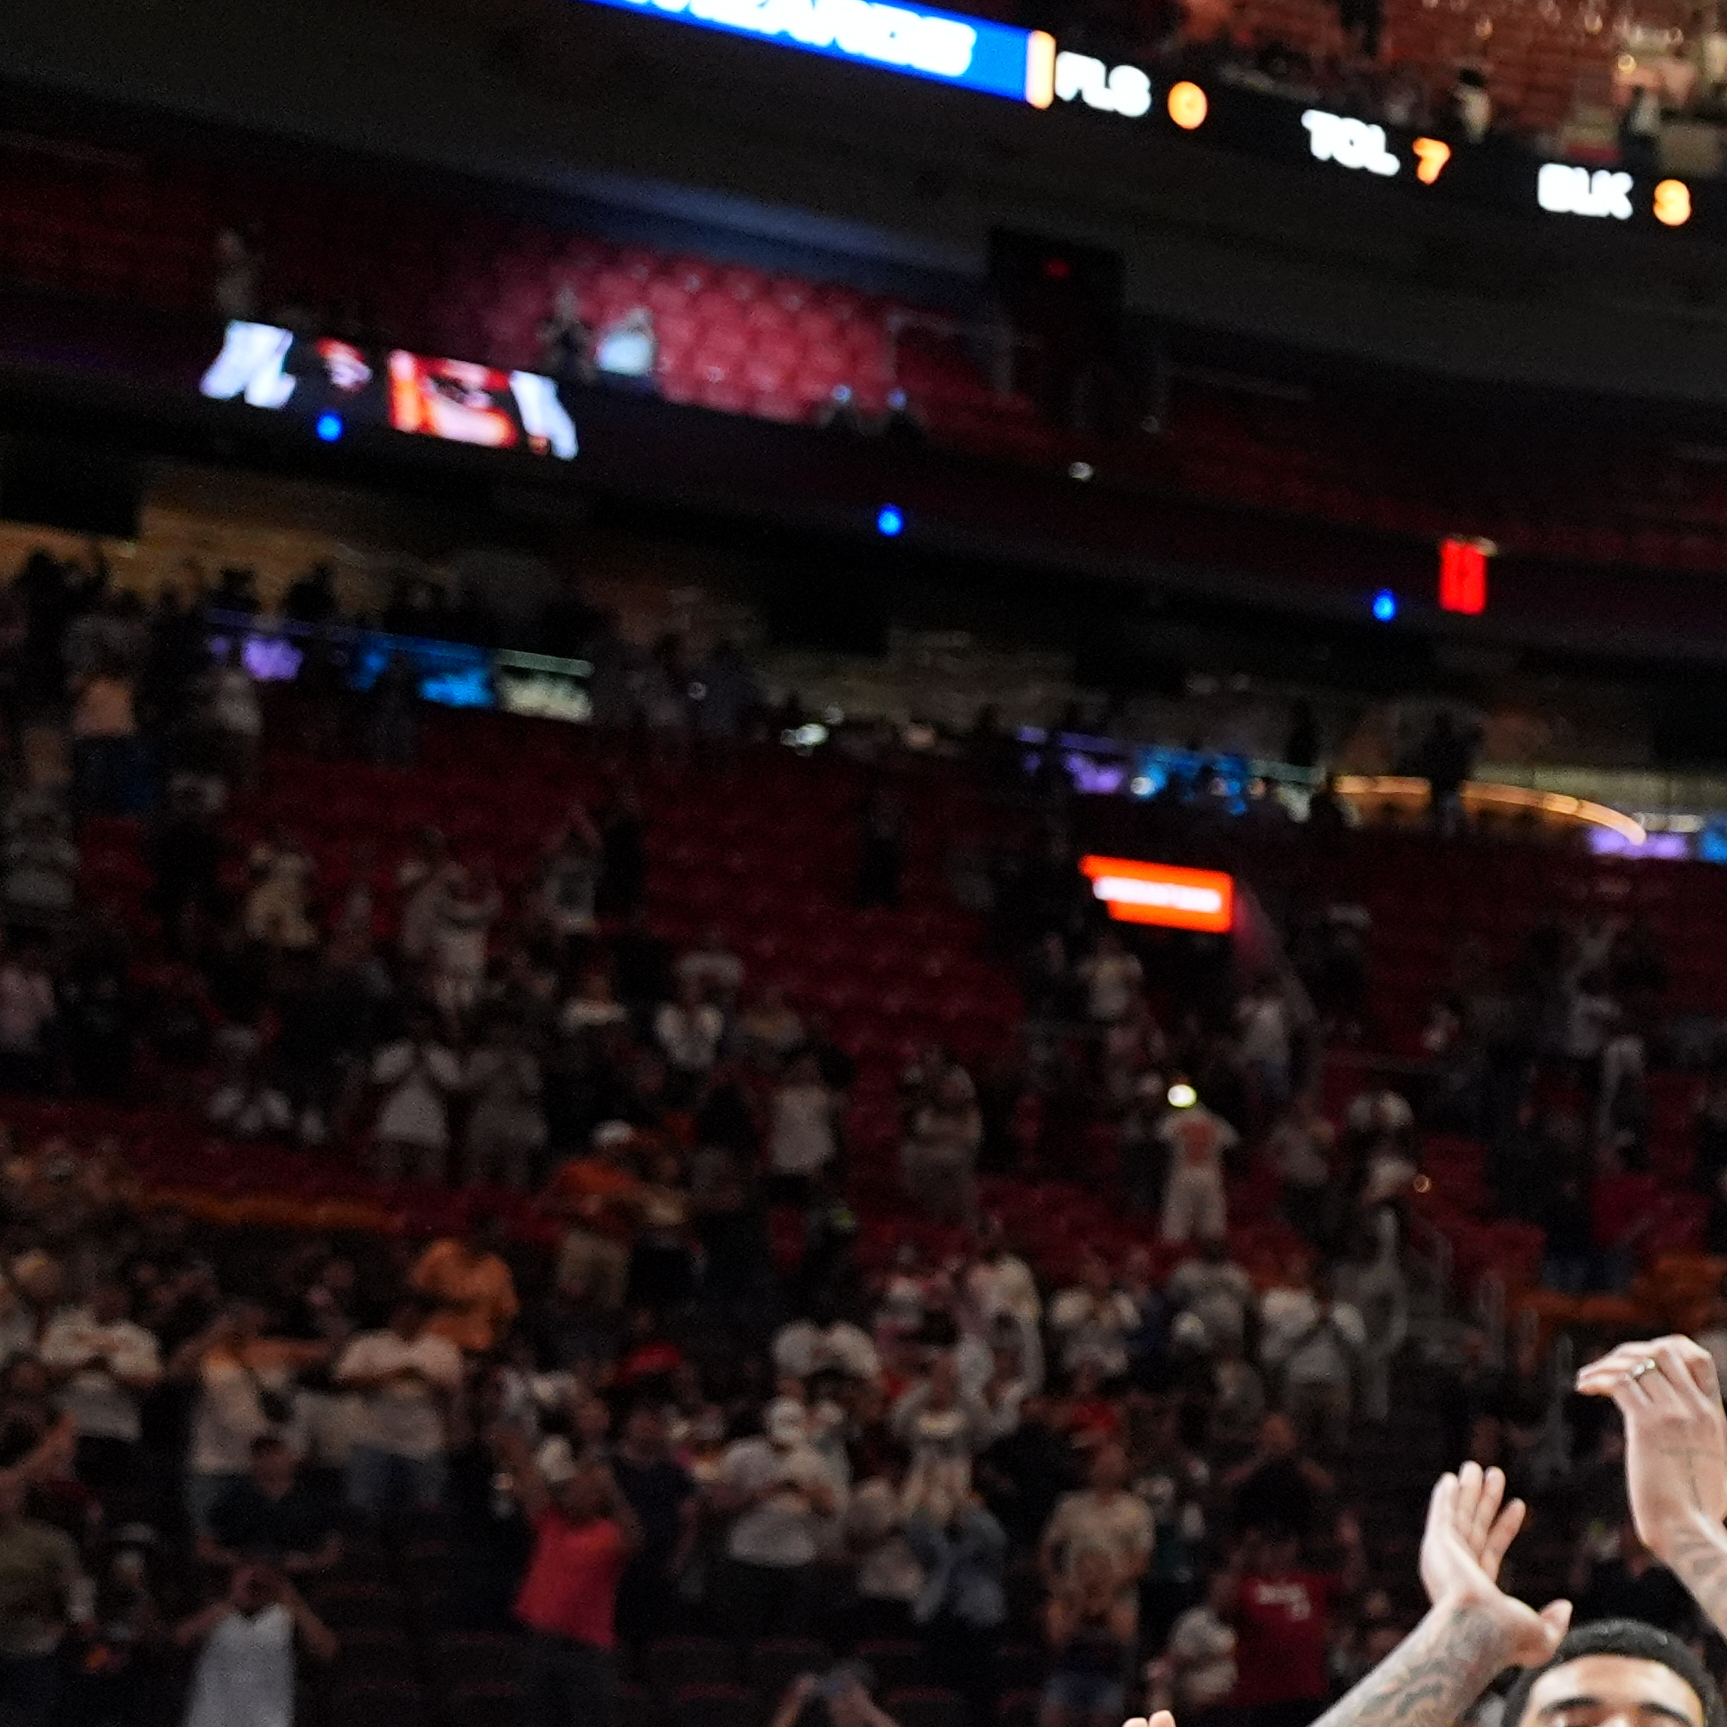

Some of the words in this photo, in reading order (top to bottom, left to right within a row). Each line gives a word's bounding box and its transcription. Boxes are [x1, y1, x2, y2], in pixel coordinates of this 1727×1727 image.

[1301, 109, 1401, 177] TOL
[1412, 137, 1451, 185] 7
[1537, 163, 1634, 220] BLK
